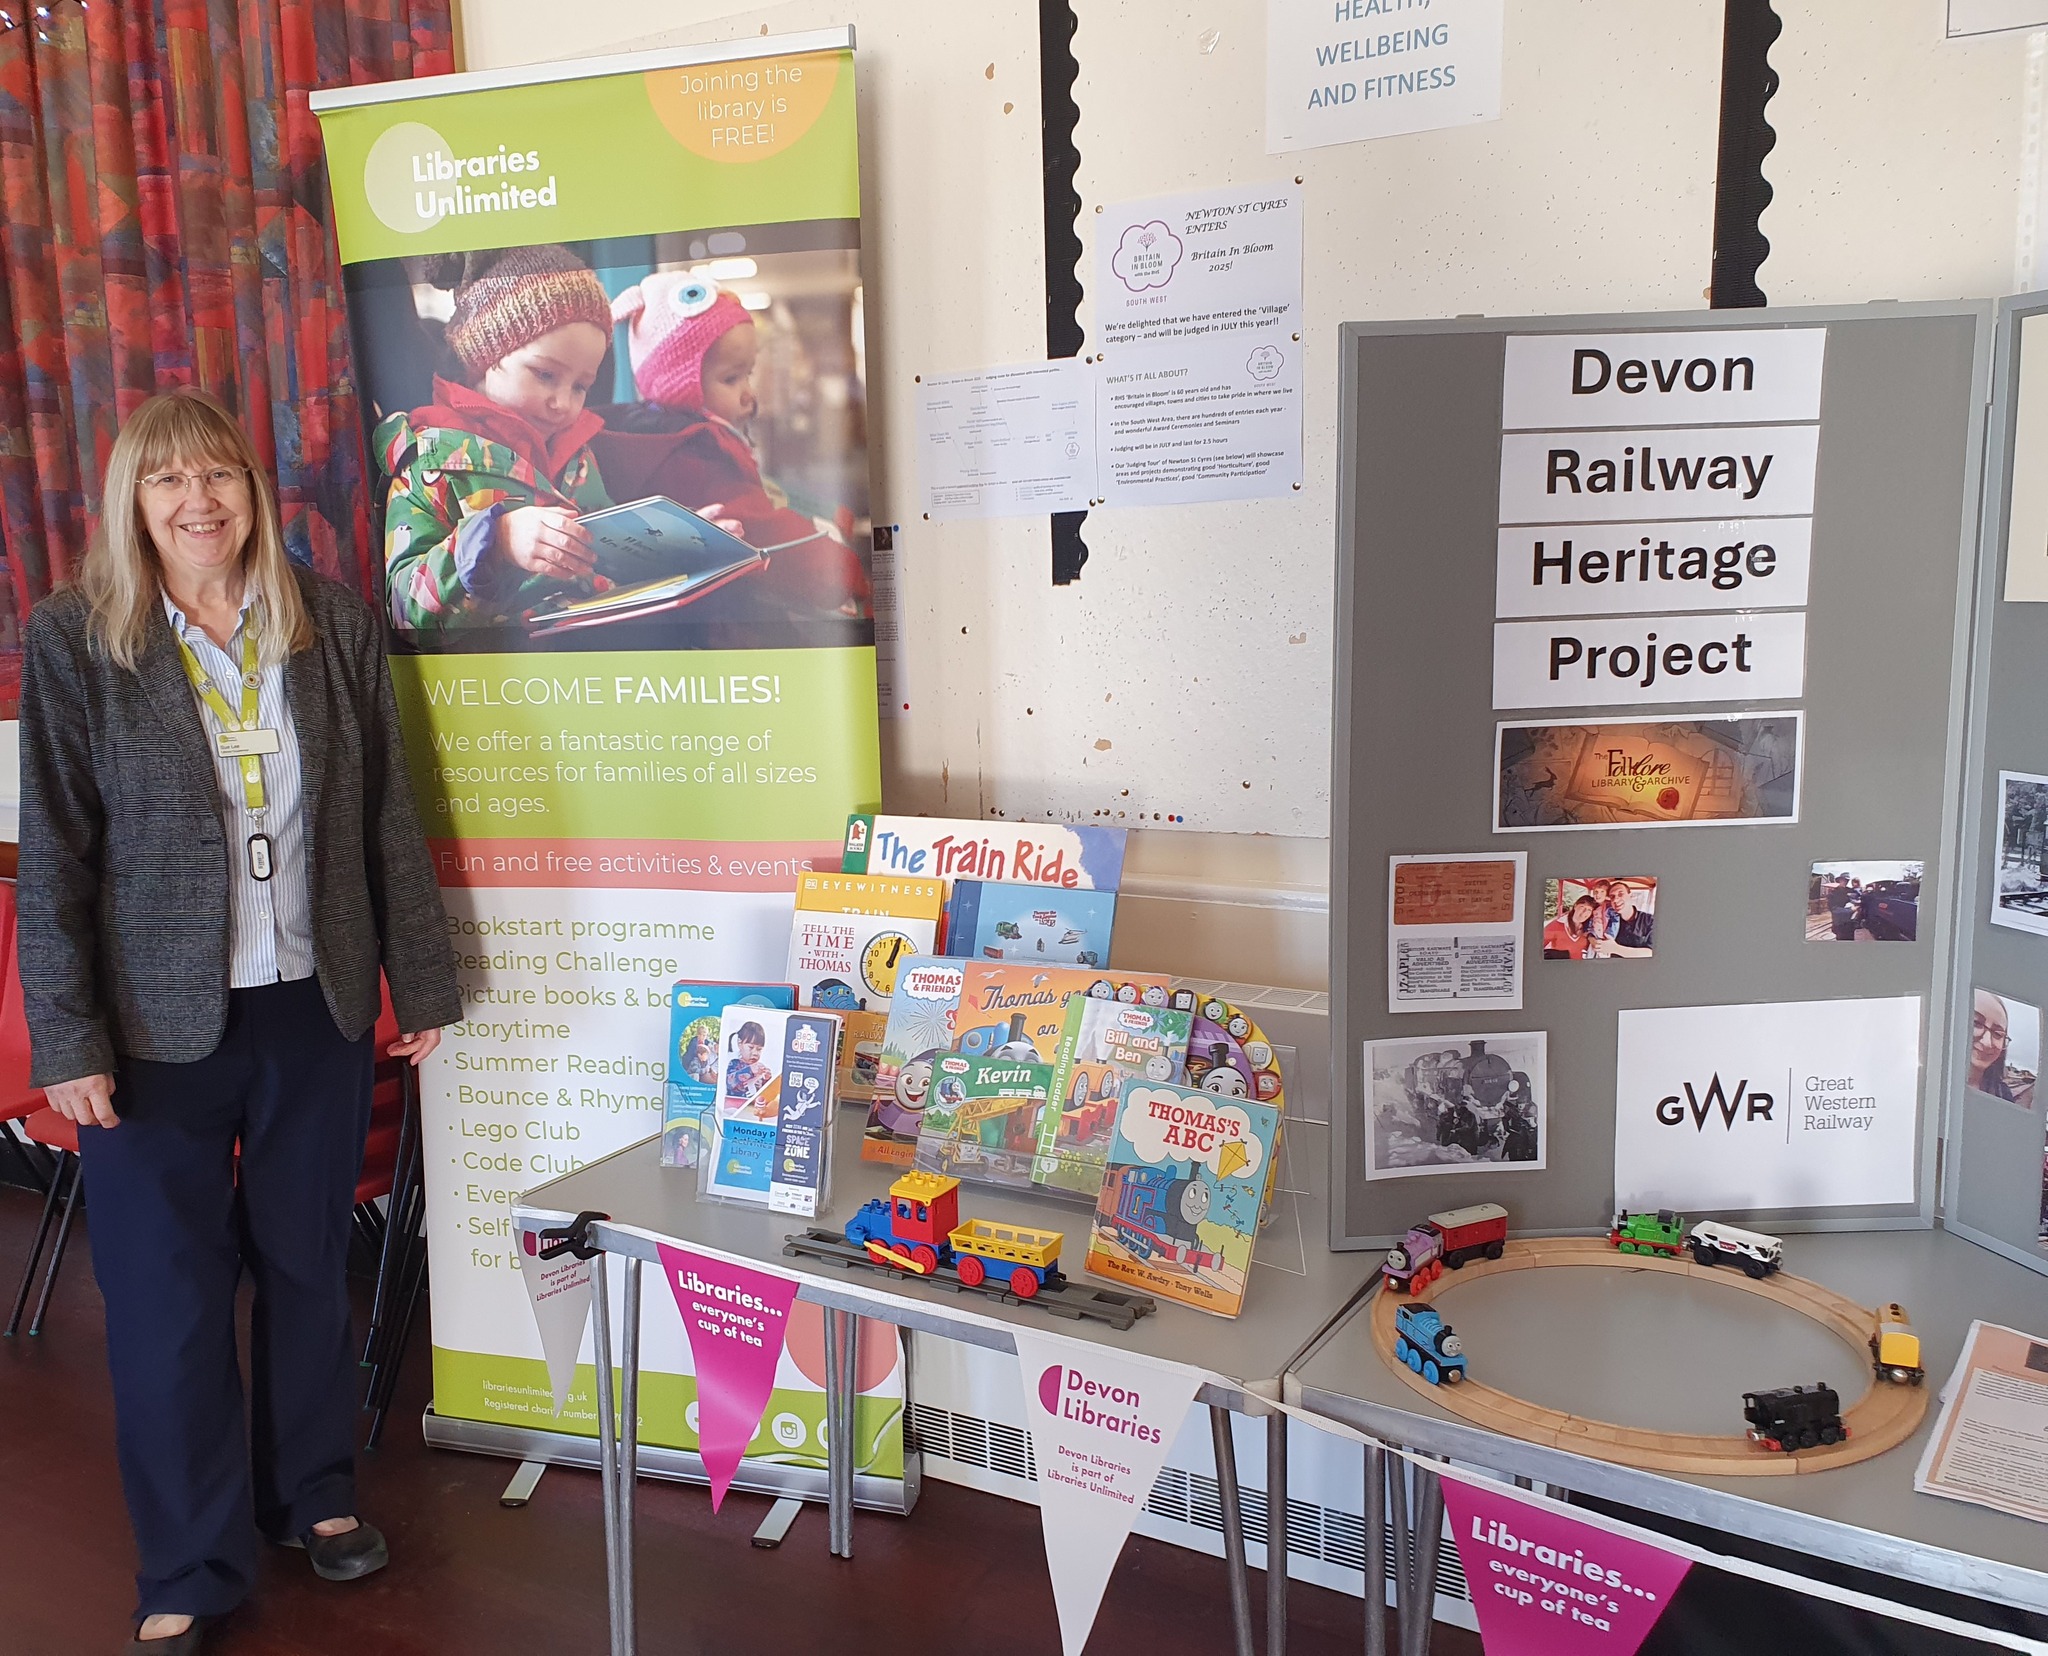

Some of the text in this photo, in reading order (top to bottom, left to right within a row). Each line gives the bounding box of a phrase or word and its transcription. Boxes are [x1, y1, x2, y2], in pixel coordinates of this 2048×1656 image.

[1316, 24, 1448, 66] WELLBEING
[680, 64, 803, 96] Joining the
[1308, 65, 1455, 109] AND FITNESS
[698, 95, 788, 122] library is
[711, 124, 776, 148] FREE!
[413, 145, 540, 182] Libraries
[415, 177, 557, 219] Unlimited
[1185, 199, 1288, 221] NEWTON ST CYRES
[1186, 221, 1227, 234] ENTERS
[1134, 253, 1160, 262] BRITAIN
[1191, 243, 1274, 261] Britain In Bloom
[1141, 261, 1162, 269] BLOOM
[1209, 261, 1233, 272] 2025!
[1126, 297, 1147, 306] SOUTH
[1105, 323, 1125, 331] We're
[1128, 318, 1160, 328] delighted
[1212, 309, 1241, 319] entered
[1106, 334, 1135, 343] category
[1159, 329, 1171, 337] will
[1184, 325, 1209, 336] judged
[1221, 322, 1237, 330] JULY
[1256, 317, 1278, 328] year!!
[1106, 375, 1133, 384] WHAT'S
[1144, 372, 1156, 380] ALL
[1158, 369, 1188, 378] ABOUT?
[1572, 349, 1754, 394] Devon
[1547, 447, 1773, 500] Railway
[1532, 537, 1776, 590] Heritage
[1549, 632, 1752, 688] Project
[423, 675, 781, 706] WELCOME FAMILIES!
[430, 729, 771, 756] We offer a fantastic range of
[433, 760, 817, 784] resources for families of all sizes
[1595, 749, 1671, 777] The Folklore
[1592, 776, 1690, 788] LIBRARY ARCHIVE
[436, 793, 550, 817] and ages.
[440, 850, 813, 876] Fun and free activities & events
[877, 831, 1078, 888] The Train Ride
[822, 881, 934, 896] EYEWITNESS
[448, 916, 715, 942] Bookstart programme
[802, 933, 854, 949] TIME
[803, 924, 854, 935] TELL THE
[451, 951, 678, 976] Reading Challenge
[799, 958, 851, 972] THOMAS
[814, 950, 838, 958] WITH
[912, 973, 961, 985] THOMAS
[457, 985, 536, 1004] Picture
[545, 986, 616, 1007] books
[624, 988, 639, 1007] &
[981, 985, 1057, 1010] Thomas
[1123, 1013, 1151, 1022] THOMAS
[453, 1019, 571, 1042] Storytime
[1037, 1024, 1058, 1036] on
[1106, 1030, 1158, 1051] Bill and
[456, 1052, 666, 1080] Summer Reading
[1115, 1049, 1141, 1063] Ben
[975, 1066, 1031, 1085] Kevin
[1051, 1036, 1073, 1111] Reading Ladder
[1805, 1076, 1854, 1092] Great
[459, 1086, 548, 1105] Bounce
[557, 1088, 572, 1106] &
[580, 1088, 664, 1113] Rhyme
[1656, 1071, 1774, 1133] GWR
[1805, 1096, 1876, 1110] Western
[461, 1119, 581, 1140] Lego Club
[733, 1126, 767, 1137] Monday
[1149, 1102, 1240, 1137] THOMAS'S
[1804, 1115, 1873, 1131] Railway
[1163, 1125, 1215, 1152] ABC
[463, 1152, 585, 1174] Code Club
[731, 1148, 761, 1159] Library
[469, 1218, 509, 1236] Self
[471, 1249, 503, 1267] for
[1107, 1260, 1213, 1299] The Rev. W. Awdry Tony Wells
[678, 1270, 782, 1318] Libraries...
[692, 1301, 764, 1332] everyone's
[698, 1318, 762, 1347] cup of tea
[1067, 1369, 1140, 1407] Devon
[484, 1398, 528, 1412] Registered
[563, 1410, 597, 1420] number
[1064, 1398, 1161, 1444] Libraries
[1059, 1445, 1131, 1475] Devon Libraries
[1072, 1462, 1114, 1483] is part of
[1048, 1469, 1135, 1504] Libraries Unlimited
[1471, 1516, 1656, 1601] Libraries...
[1489, 1560, 1619, 1613] everyone's
[1494, 1582, 1610, 1632] cup of tea
